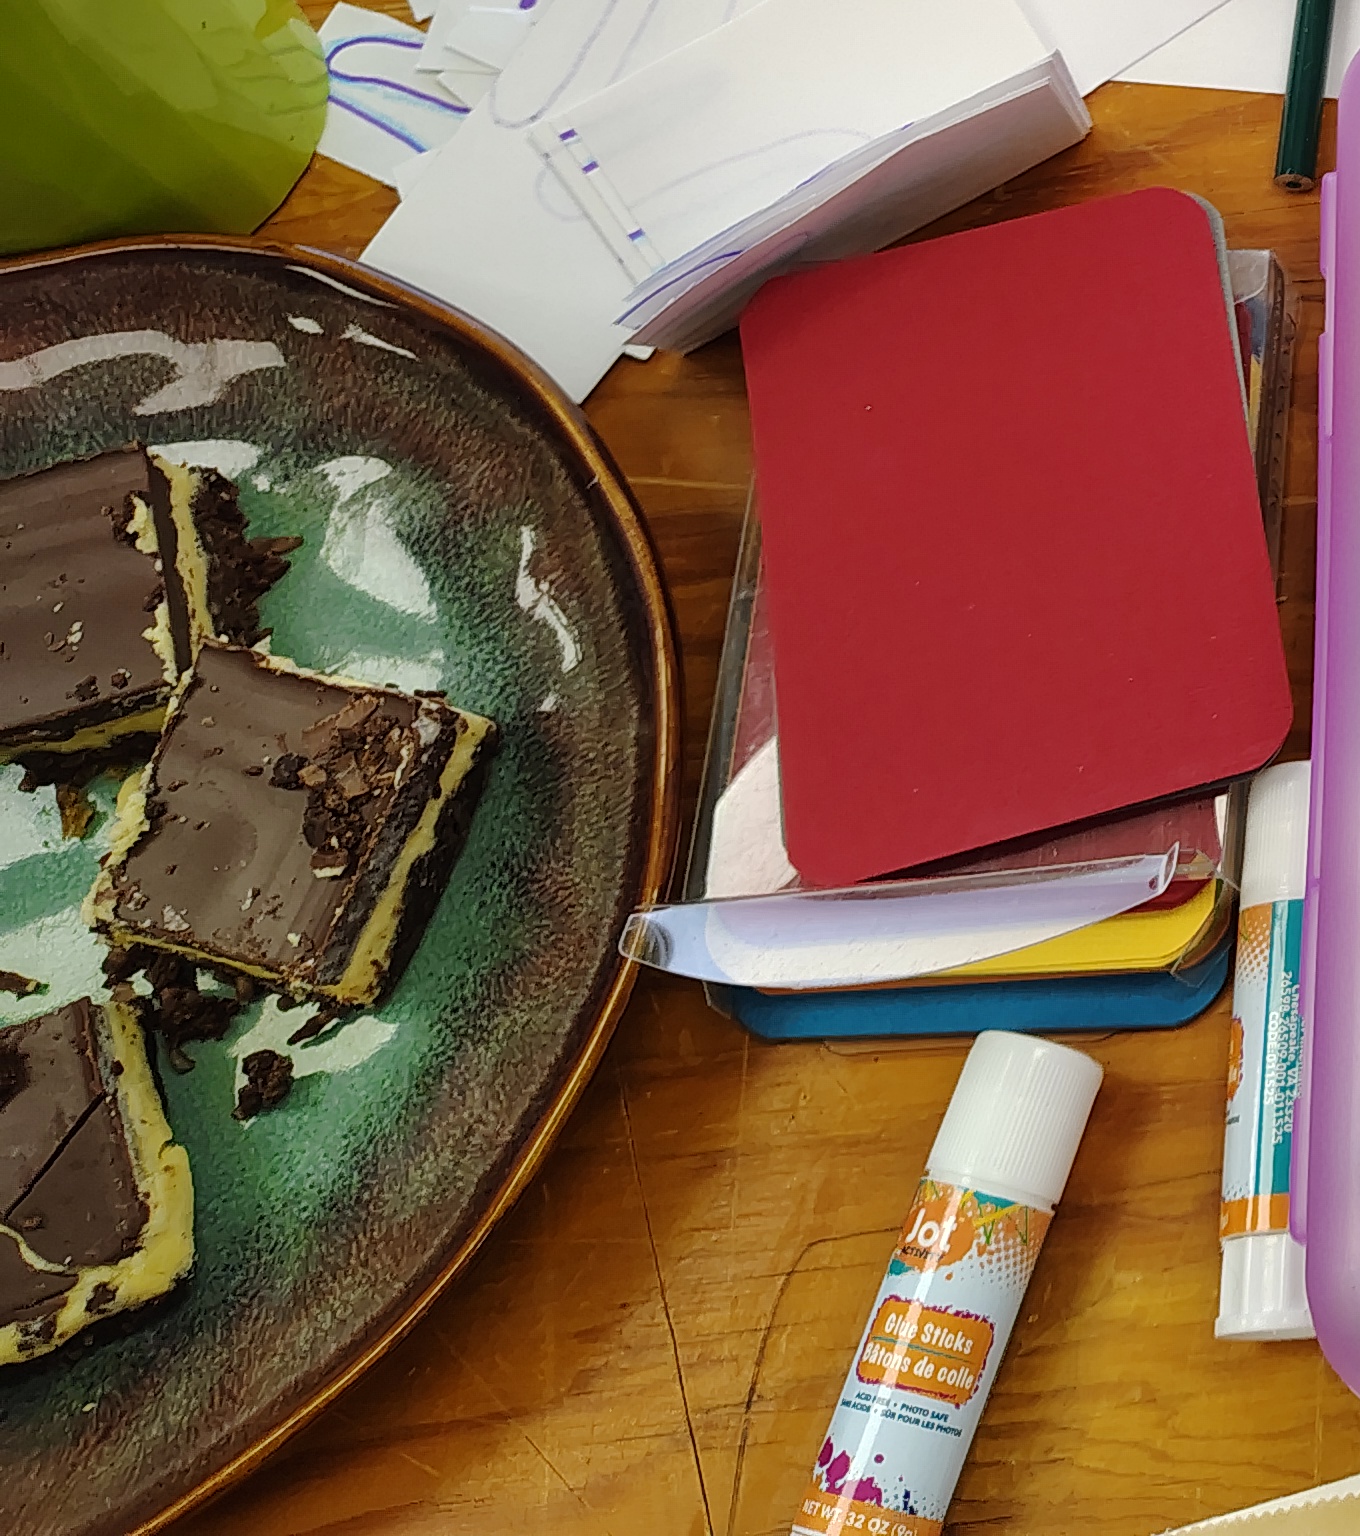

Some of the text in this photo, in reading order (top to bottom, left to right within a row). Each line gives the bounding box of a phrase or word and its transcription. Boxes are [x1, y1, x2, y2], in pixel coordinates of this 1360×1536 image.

[905, 1208, 958, 1253] Jot
[885, 1312, 974, 1356] Glue Sticks
[862, 1342, 975, 1390] Bâtons de colle
